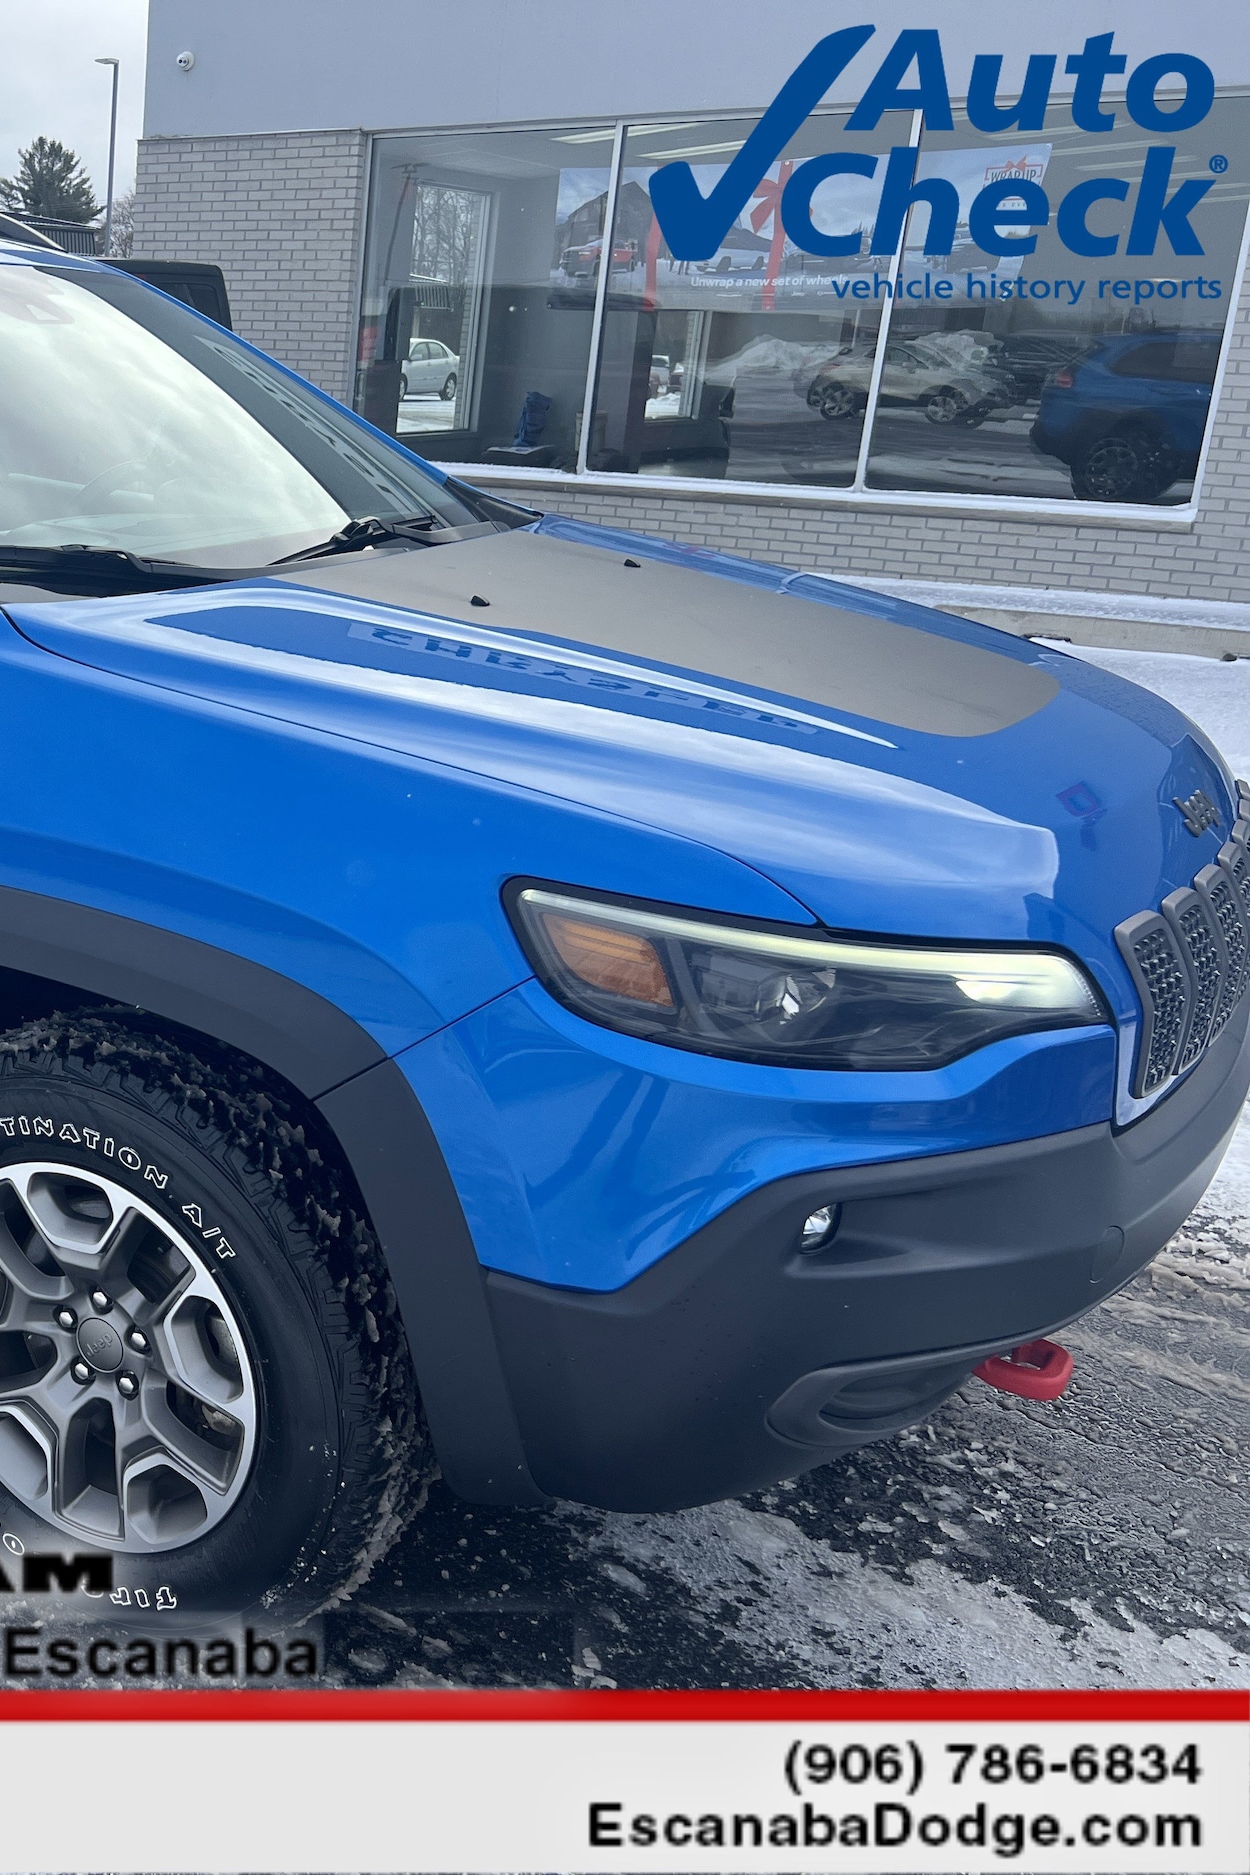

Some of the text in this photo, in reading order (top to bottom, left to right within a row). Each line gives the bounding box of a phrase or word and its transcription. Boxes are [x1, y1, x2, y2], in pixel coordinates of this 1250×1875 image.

[690, 276, 733, 289] Unwrap
[744, 278, 770, 287] new
[771, 276, 790, 287] set
[791, 275, 805, 286] of
[182, 1202, 237, 1260] A/T
[86, 1333, 113, 1357] Jeep
